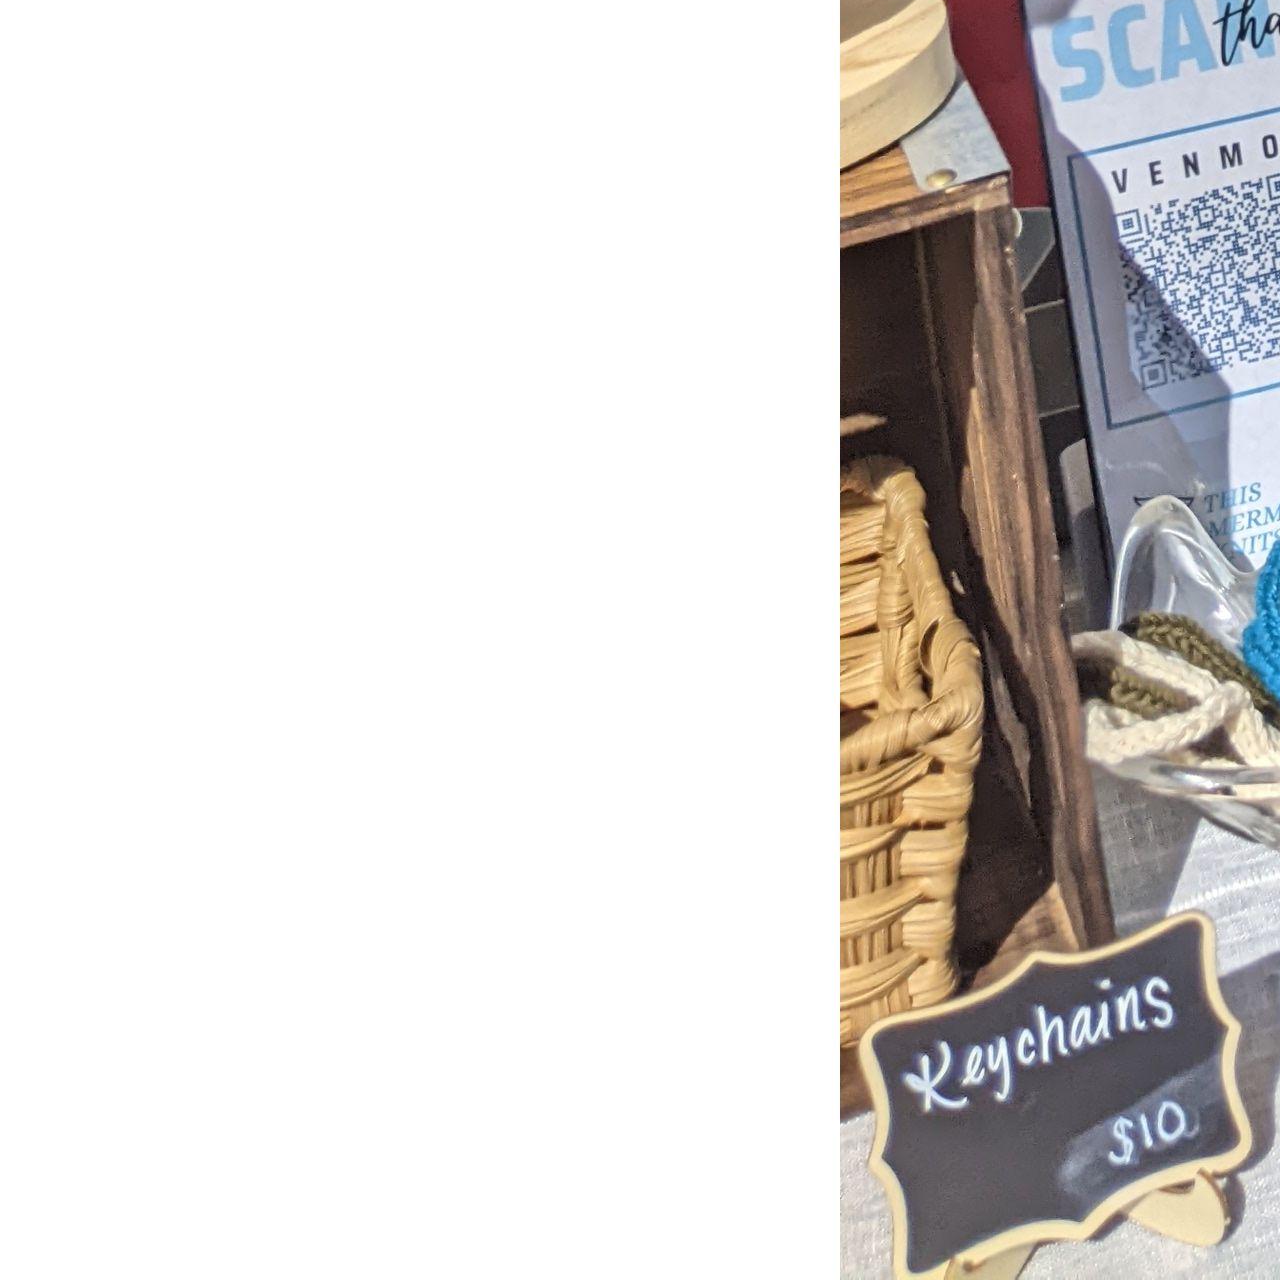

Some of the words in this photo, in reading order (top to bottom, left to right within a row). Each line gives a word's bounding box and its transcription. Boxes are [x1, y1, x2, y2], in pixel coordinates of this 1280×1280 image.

[1110, 133, 1280, 195] VENMO
[1203, 481, 1262, 513] THIS
[903, 976, 1179, 1113] Keychains
[1108, 1100, 1190, 1167] $10
